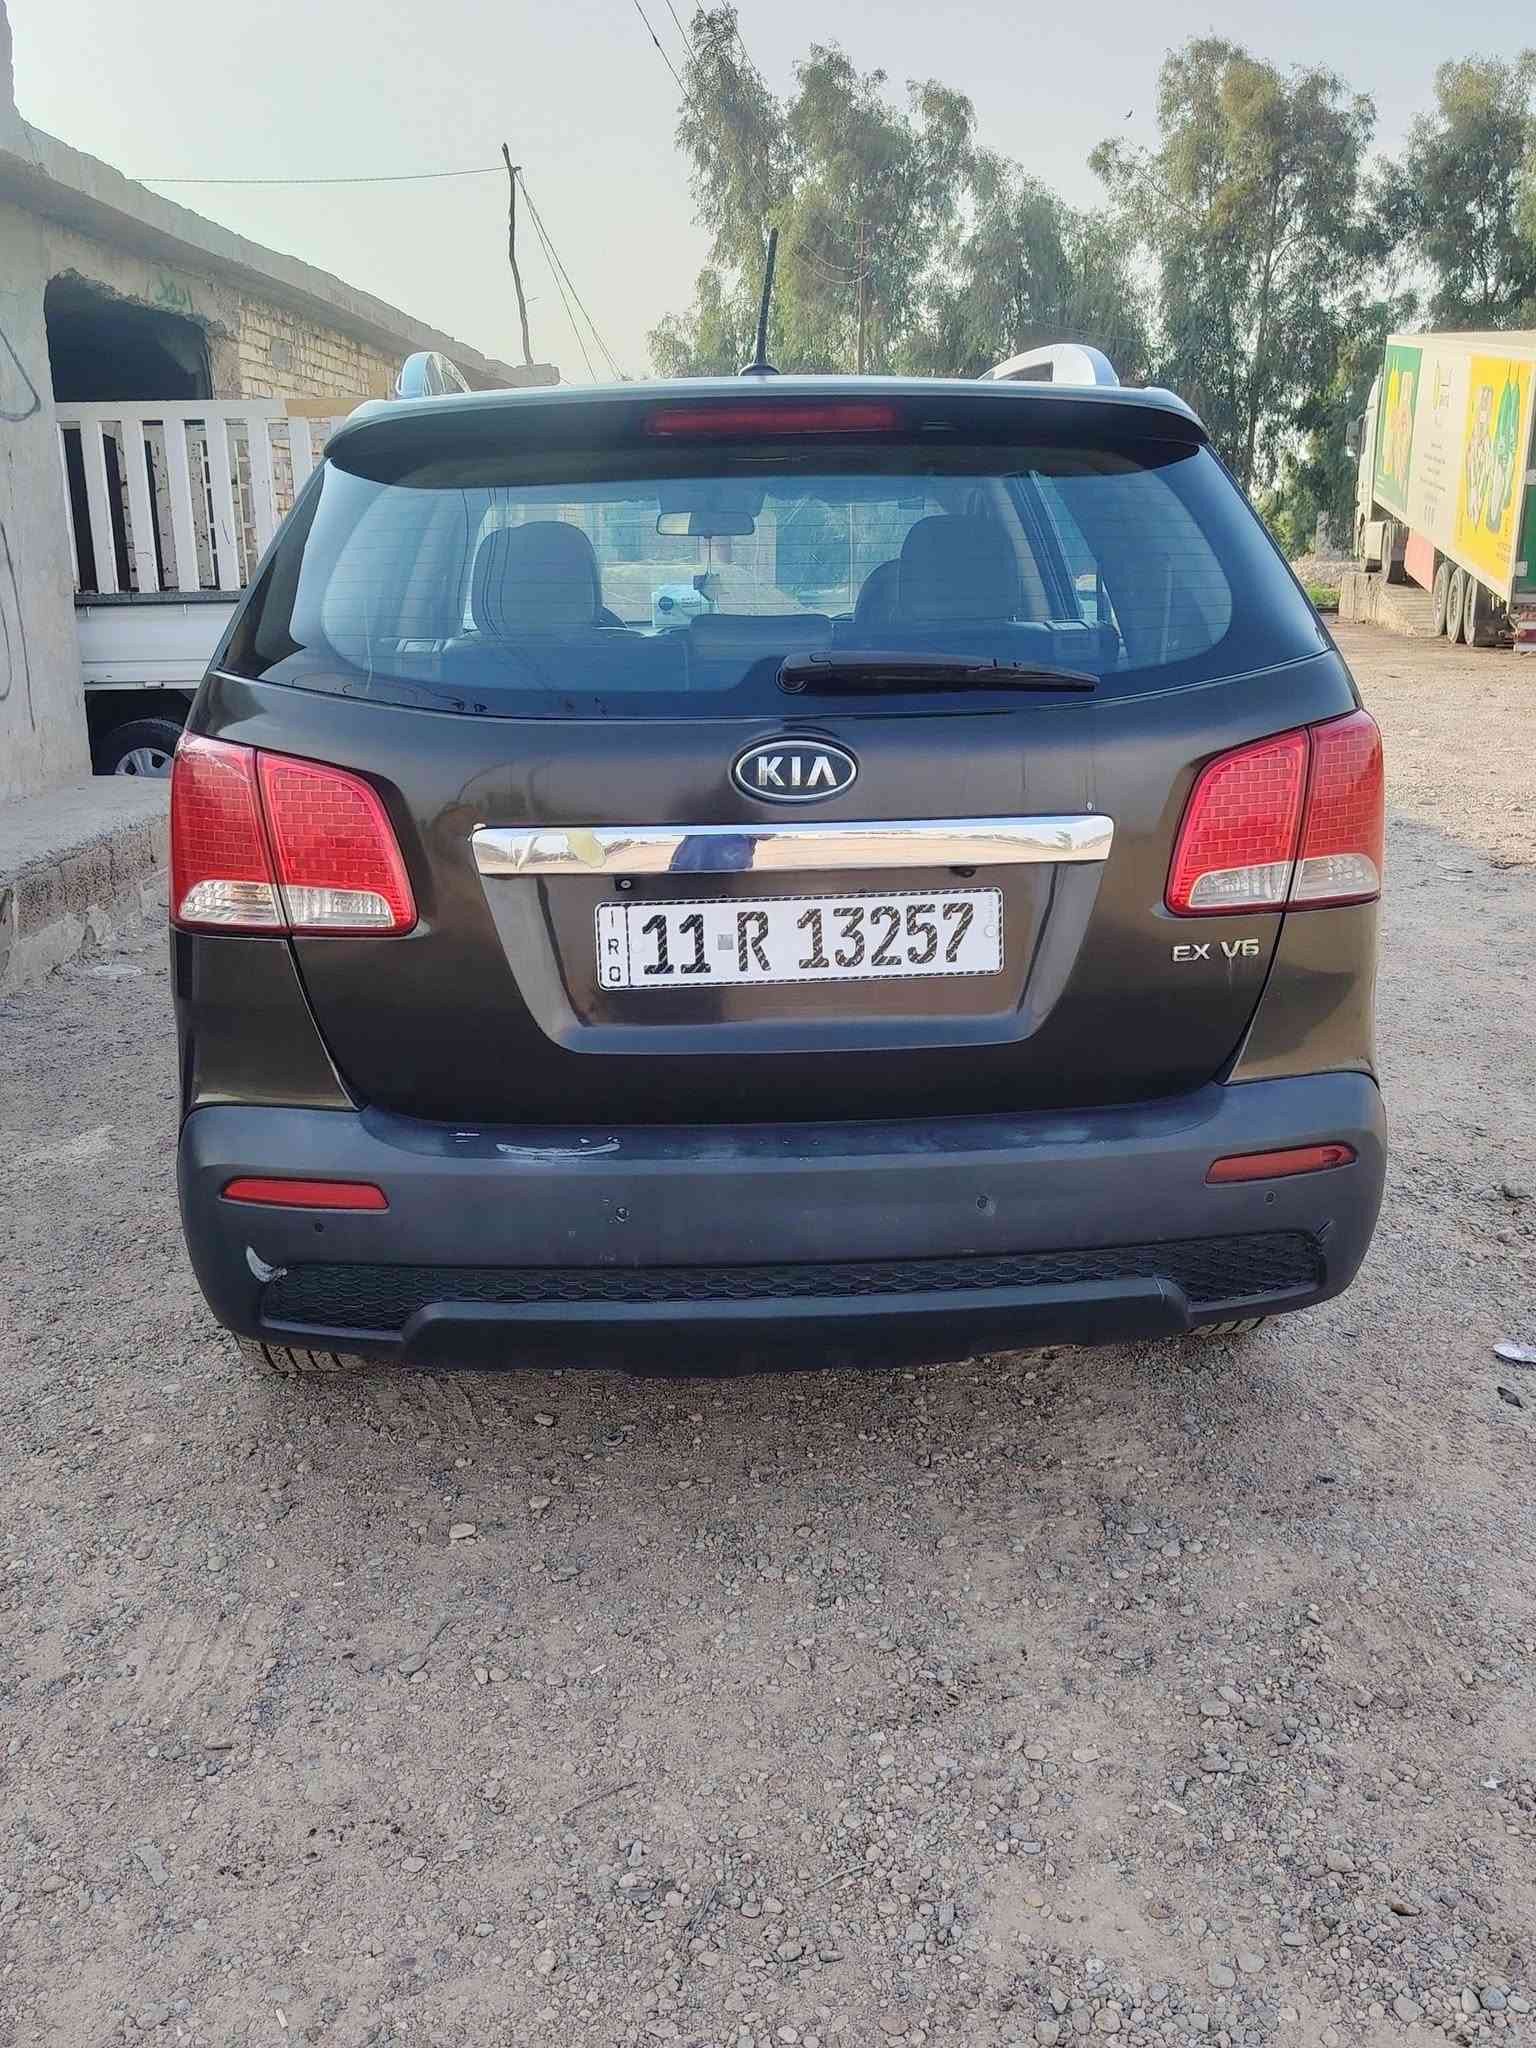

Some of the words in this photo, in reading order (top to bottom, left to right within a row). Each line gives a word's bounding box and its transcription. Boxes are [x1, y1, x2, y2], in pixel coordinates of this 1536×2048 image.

[757, 756, 837, 786] KIA
[642, 913, 711, 976] 11
[737, 911, 770, 972] R
[797, 901, 975, 970] 13257
[1172, 943, 1211, 962] EX
[1219, 938, 1260, 958] V6
